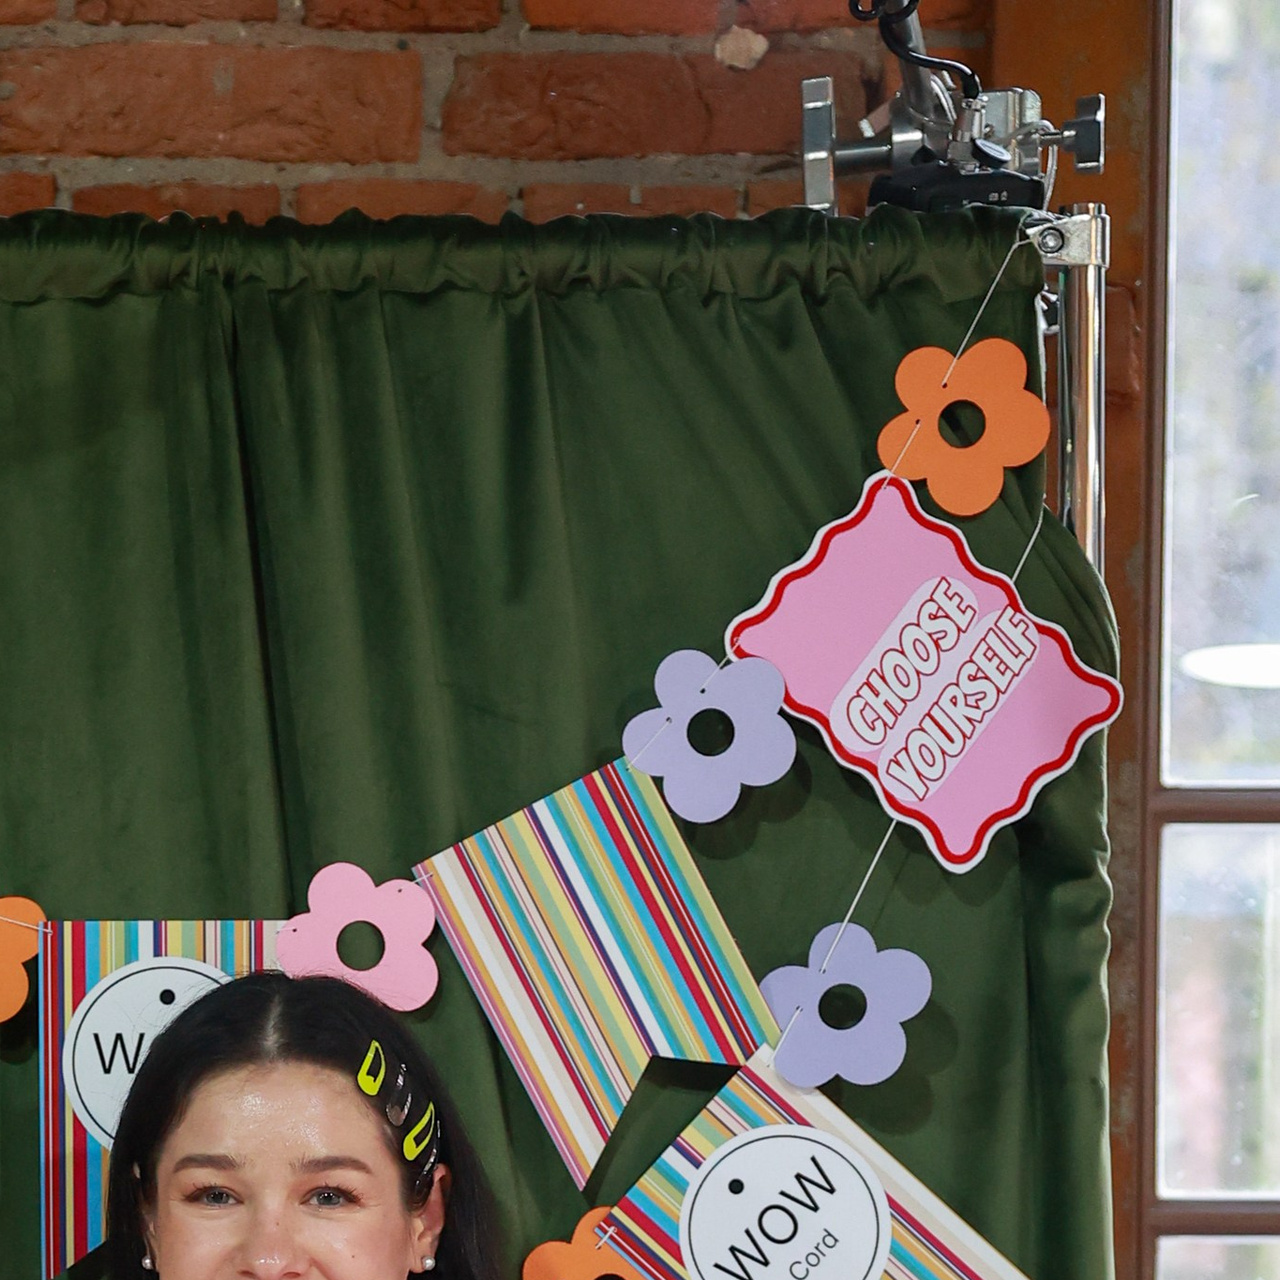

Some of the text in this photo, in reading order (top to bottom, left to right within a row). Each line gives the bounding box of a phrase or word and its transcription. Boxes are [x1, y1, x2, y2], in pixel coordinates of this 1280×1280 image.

[846, 576, 977, 746] CHOOSE
[886, 604, 1037, 802] YOURSELF
[789, 1228, 839, 1280] Cord
